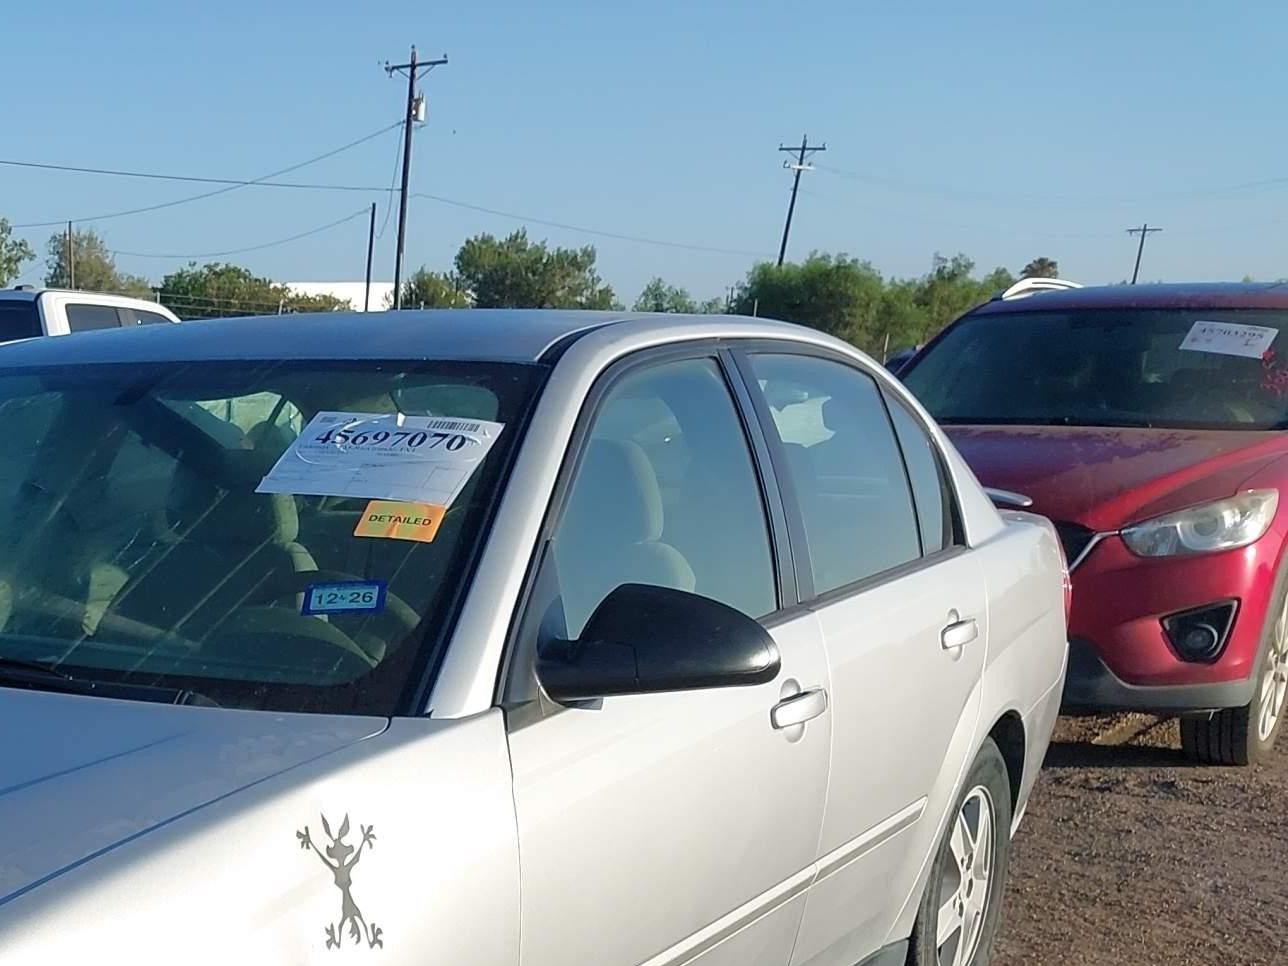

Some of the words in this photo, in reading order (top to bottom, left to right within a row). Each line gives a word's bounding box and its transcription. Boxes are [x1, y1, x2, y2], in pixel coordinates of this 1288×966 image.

[315, 429, 466, 452] 45697070
[368, 514, 432, 526] DETAILED
[316, 592, 339, 605] 12
[349, 591, 374, 603] 26
